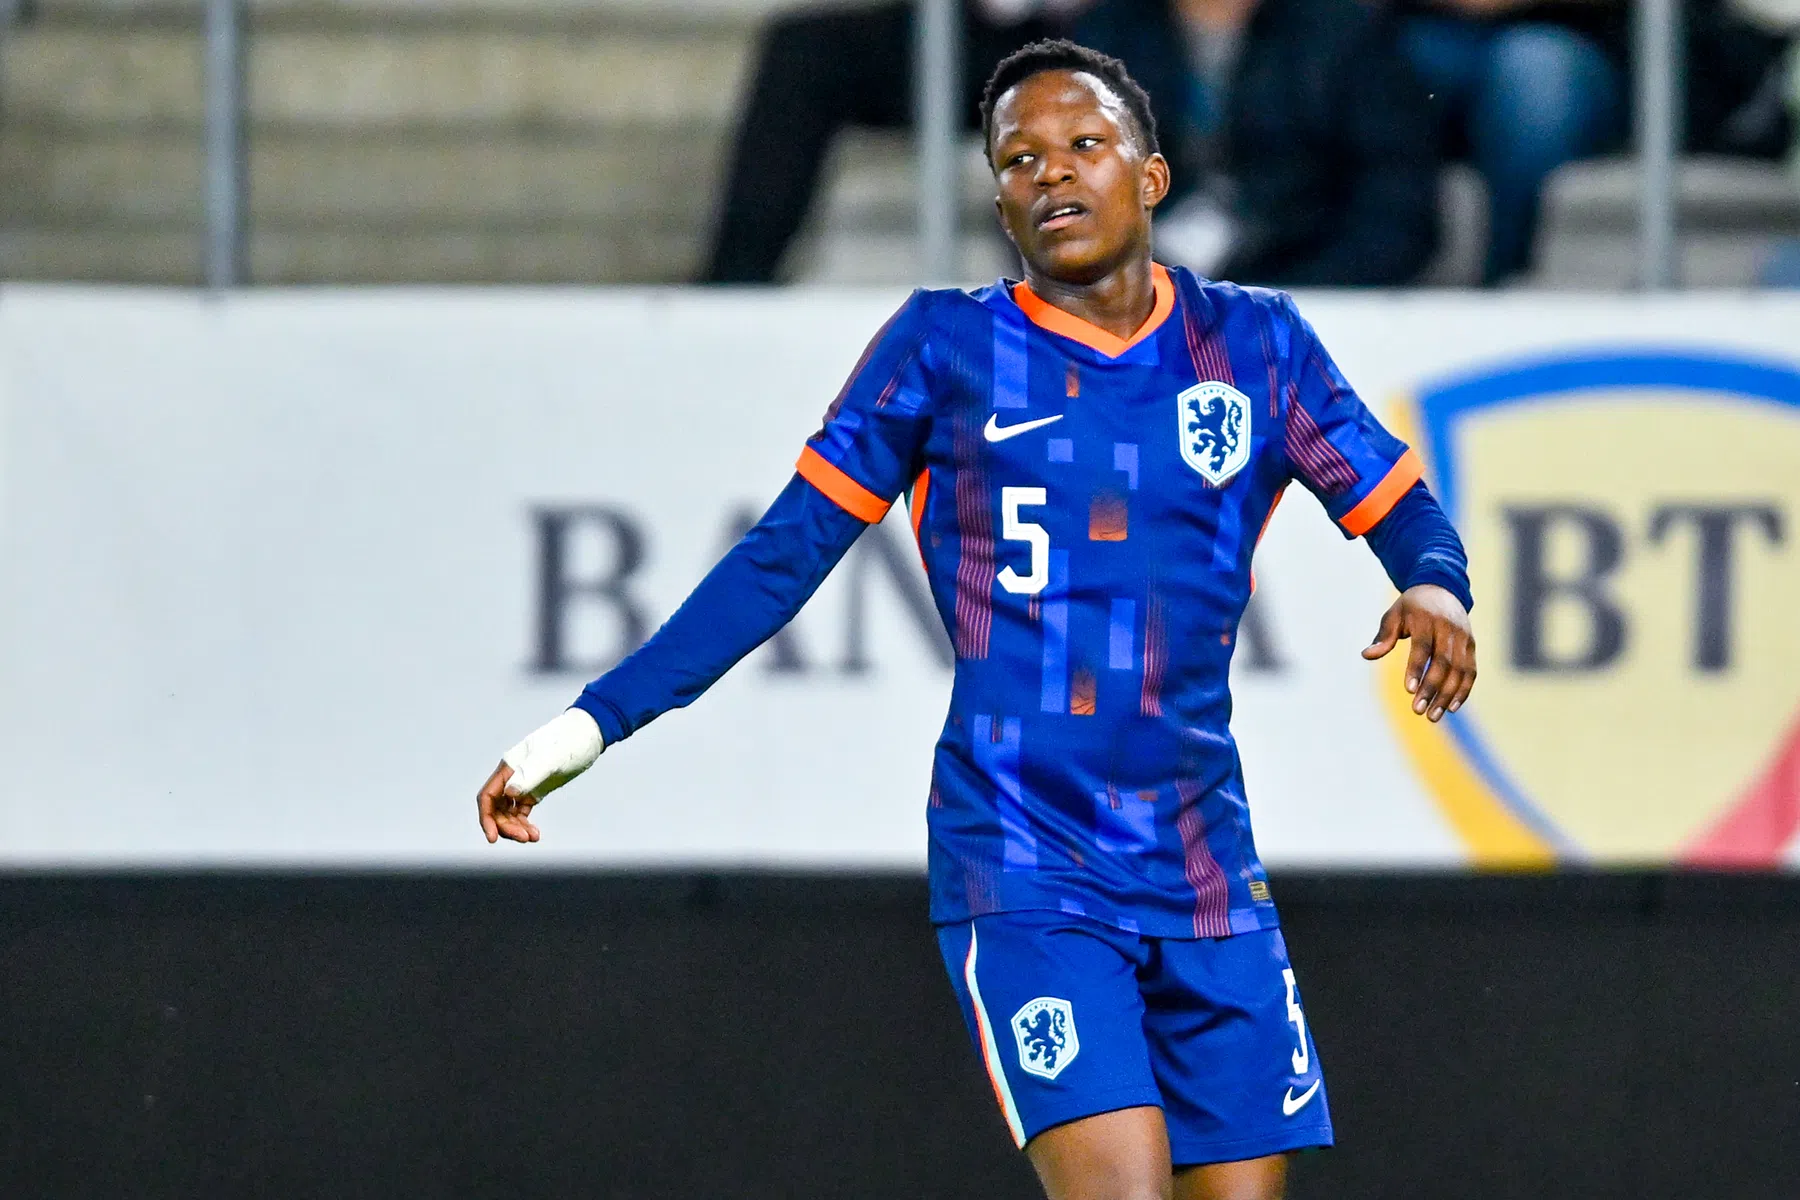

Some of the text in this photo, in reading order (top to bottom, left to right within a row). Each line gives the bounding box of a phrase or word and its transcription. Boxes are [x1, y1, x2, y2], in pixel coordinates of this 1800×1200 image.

[997, 486, 1049, 593] 5
[1500, 501, 1783, 674] BT
[1282, 967, 1308, 1074] 5
